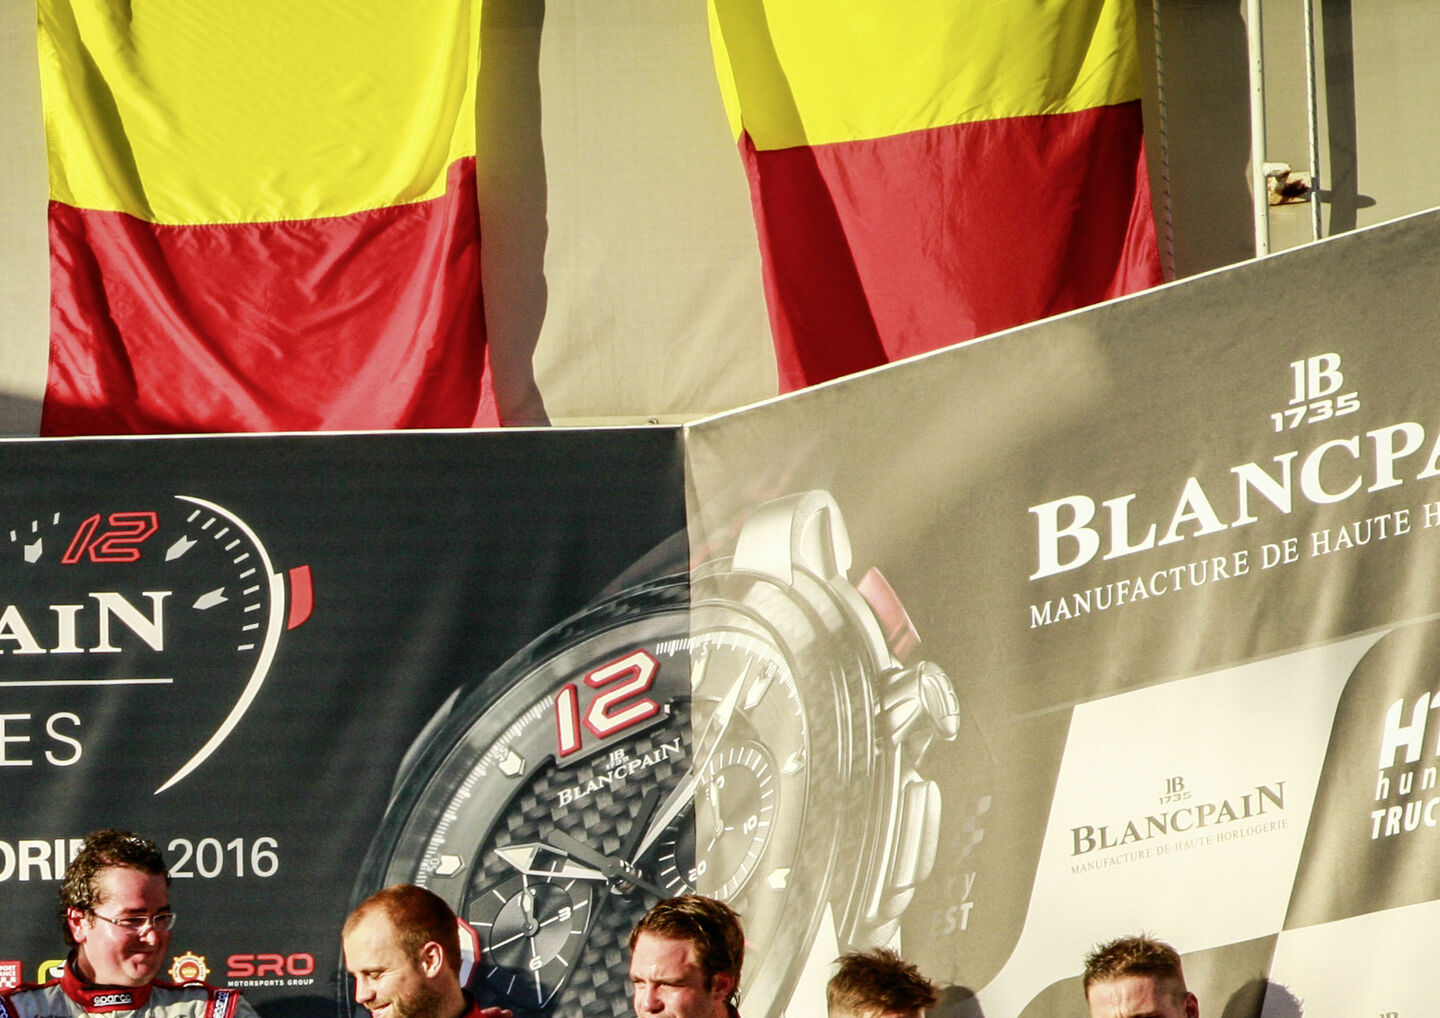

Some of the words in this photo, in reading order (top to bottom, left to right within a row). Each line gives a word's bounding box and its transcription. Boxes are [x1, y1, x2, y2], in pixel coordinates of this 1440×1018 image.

[1271, 391, 1361, 433] 1735
[1030, 550, 1250, 630] MANUFACTURE
[1261, 537, 1299, 571] DE
[1311, 508, 1411, 558] HAUTE
[553, 647, 661, 757] 12
[557, 736, 682, 808] BLANCPAIN
[1375, 766, 1437, 801] hun
[1070, 781, 1288, 857] BLANCPAIN
[1159, 792, 1193, 805] 1735
[1371, 796, 1440, 840] TRUC
[169, 837, 279, 878] 2016
[1070, 847, 1154, 876] MANUFACTURE
[1156, 844, 1171, 856] DE
[1174, 834, 1213, 853] HAUTE
[1216, 818, 1289, 844] HORLOGERIE
[227, 953, 315, 977] SRO
[287, 978, 315, 986] GROUP
[93, 993, 132, 1005] sparco
